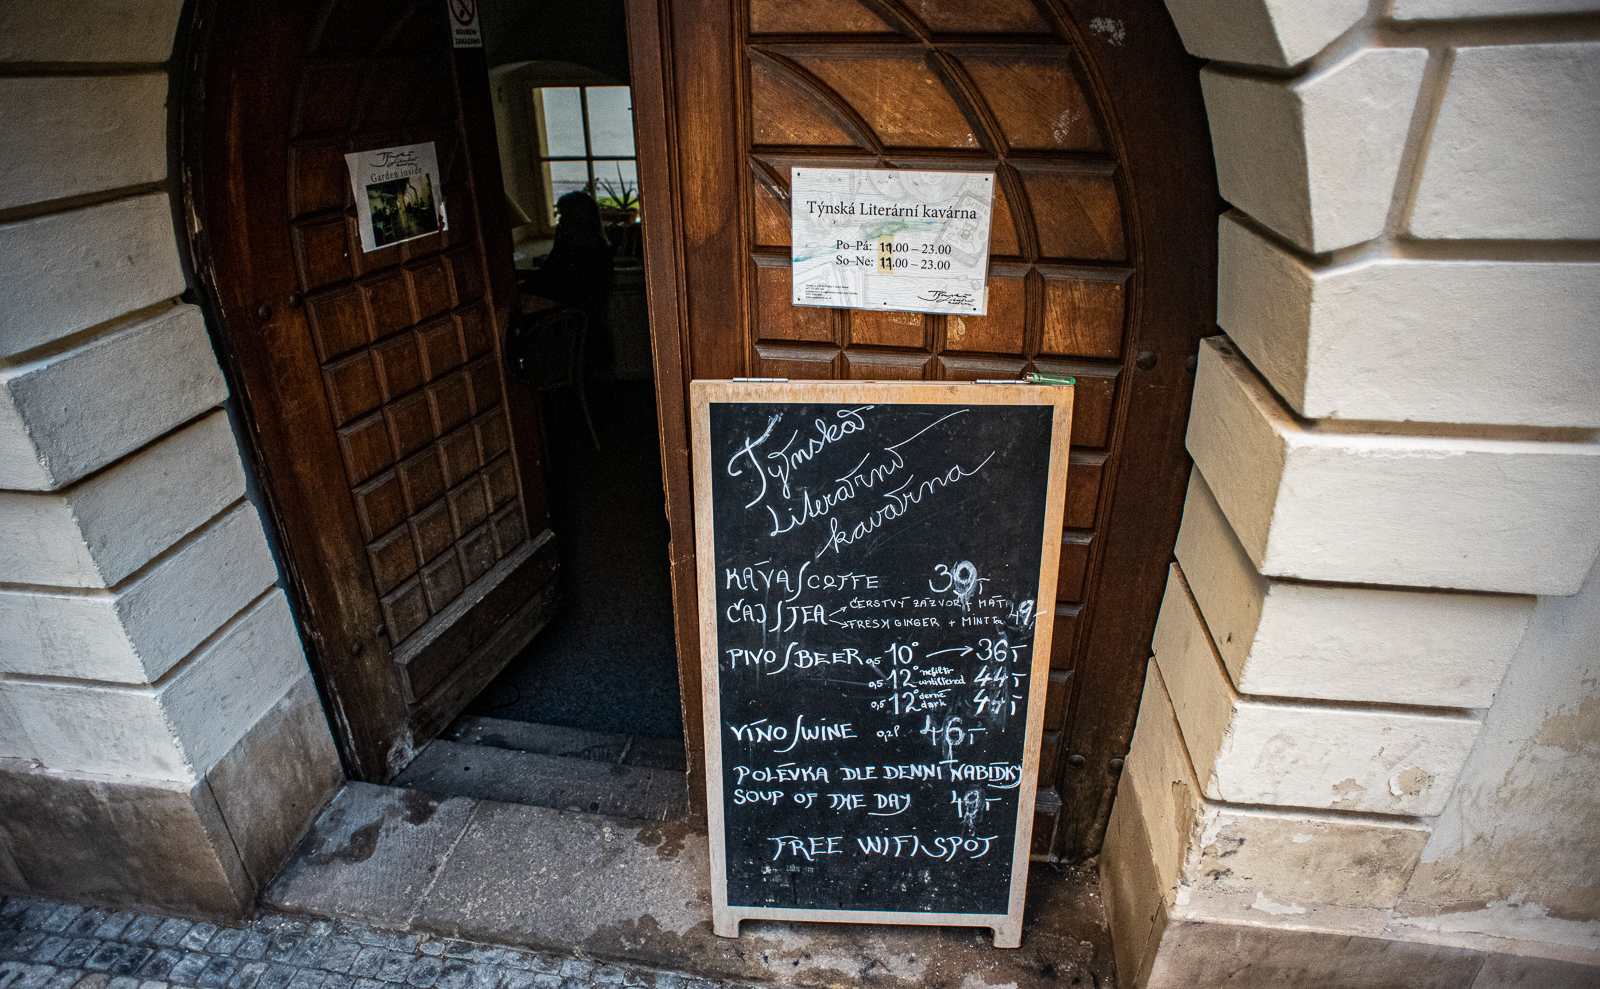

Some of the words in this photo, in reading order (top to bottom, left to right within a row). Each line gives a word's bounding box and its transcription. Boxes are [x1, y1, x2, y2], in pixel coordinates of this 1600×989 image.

[370, 170, 399, 182] Garden
[401, 166, 422, 177] inside
[806, 200, 855, 218] Týnská
[860, 202, 919, 218] Literární
[923, 204, 977, 220] kavárna
[879, 242, 909, 255] 11.00
[921, 244, 952, 255] 23.00
[879, 257, 909, 270] 11.00
[921, 259, 951, 271] 23.00
[728, 405, 875, 509] Týnská
[766, 408, 969, 537] Literární
[816, 450, 995, 558] kavárna
[894, 617, 940, 628] GINGER
[920, 699, 947, 709] dark
[733, 762, 830, 785] POLÉVKA
[839, 766, 878, 781] DLE
[733, 788, 785, 806] SOUP
[793, 792, 818, 809] OF
[826, 793, 867, 810] THE
[868, 793, 911, 816] DAY
[767, 835, 844, 861] FREE
[921, 835, 999, 862] SPOT
